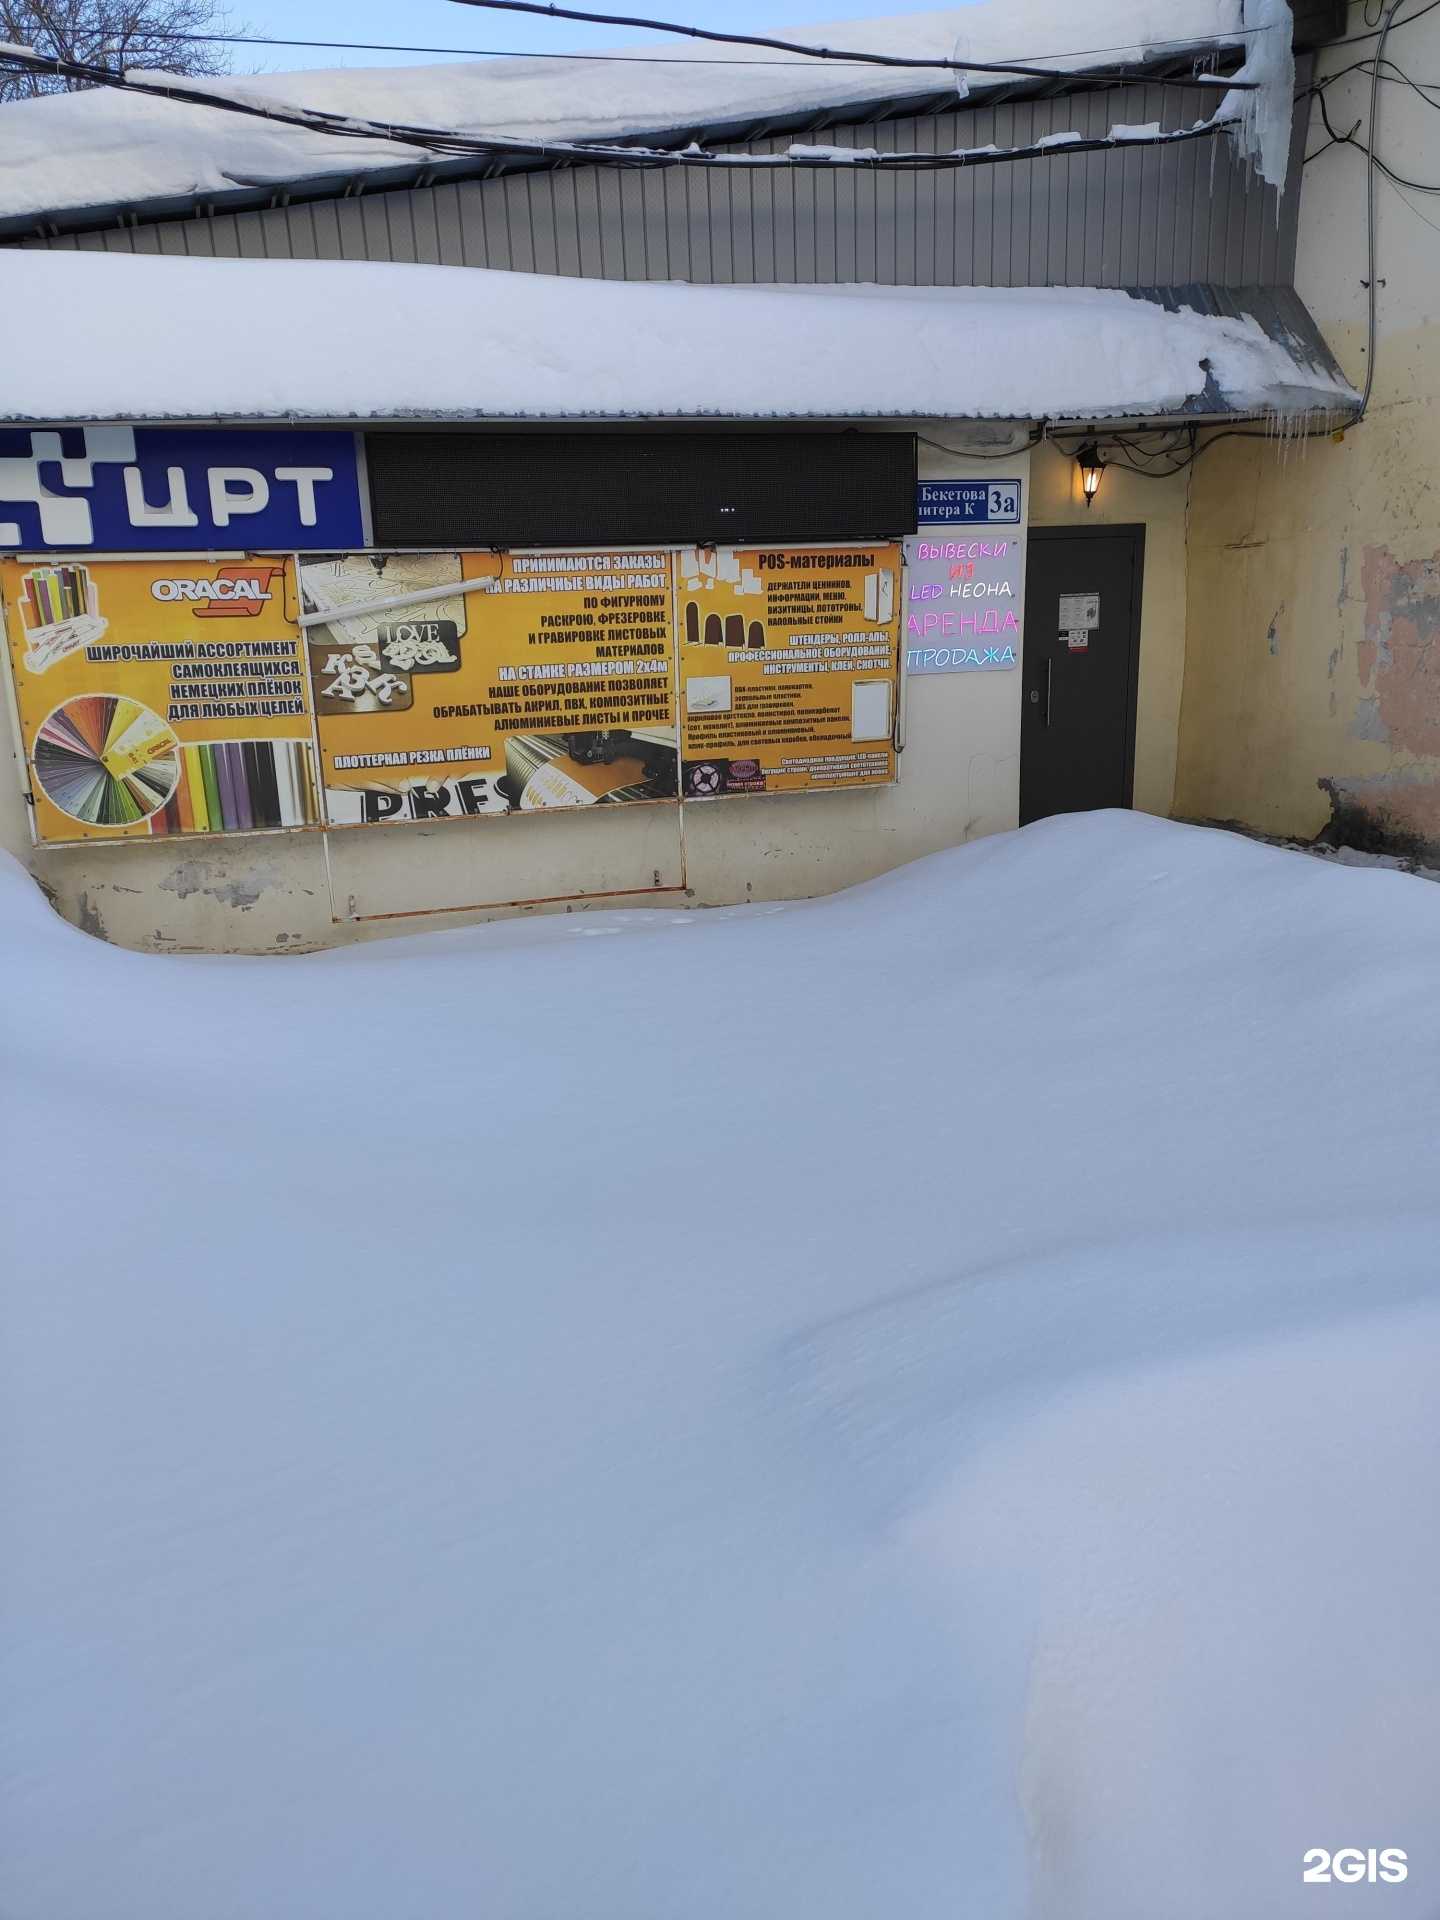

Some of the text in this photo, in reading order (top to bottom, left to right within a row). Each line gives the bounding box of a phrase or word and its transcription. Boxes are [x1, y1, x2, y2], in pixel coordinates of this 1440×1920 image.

[124, 466, 334, 527] ЦРТ
[922, 486, 986, 501] Бекетова
[990, 490, 1015, 514] 3а
[964, 502, 974, 515] К
[917, 542, 1008, 560] ВЫВЕСКИ
[512, 555, 665, 573] ПРИНИМАЮТСЯ ЗАКАЗЫ
[758, 553, 875, 570] POS-материалы
[151, 579, 272, 601] ORACAL
[504, 575, 583, 593] РАЗЛИЧНЫЕ
[585, 574, 625, 592] ВИДЫ
[627, 573, 666, 588] РАБОТ
[767, 580, 811, 592] ДЕРЖАТЕЛИ
[910, 581, 1012, 600] LED НЕОНА
[583, 594, 665, 609] ПО ФИГУРНОМУ
[540, 611, 666, 627] РАСКРОЮ, ФРЕЗЕРОВКЕ
[767, 615, 843, 626] НАПОЛЬНЫЕ СТОЙКИ
[907, 609, 1018, 636] АРЕНДА
[528, 627, 667, 645] И ГРАВИРОВКЕ ЛИСТОВЫХ
[789, 633, 841, 647] ШТЕНДЕРЫ,
[86, 641, 297, 662] ШИРОЧАЙШИЙ АССОРТИМЕНТ
[595, 643, 665, 658] МАТЕРИАЛОВ
[728, 648, 823, 663] ПРОФЕССИОНАЛЬНОЕ
[906, 646, 1015, 668] ПРОДАЖА
[172, 661, 300, 679] САМОКЛЕЯЩИХСЯ
[498, 666, 516, 681] НА
[518, 664, 566, 680] СТАНКЕ
[567, 660, 634, 677] РАЗМЕРОМ
[170, 679, 302, 699] НЕМЕЦКИХ ПЛЁНОК
[488, 677, 669, 699] НАШЕ ОБОРУДОВАНИЕ ПОЗВОЛЯЕТ
[168, 697, 304, 721] ДЛЯ ЛЮБЫХ ЦЕЛЕЙ
[433, 692, 669, 719] ОБРАБАТЫВАТЬ АКРИЛ, ПВХ, КОМПОЗИТНЫЕ
[494, 708, 670, 731] АЛЮМИНИЕВЫЕ ЛИСТЫ И ПРОЧЕЕ
[334, 744, 491, 769] ПЛОТТЕРНАЯ РЕЗКА ПЛЁНКИ
